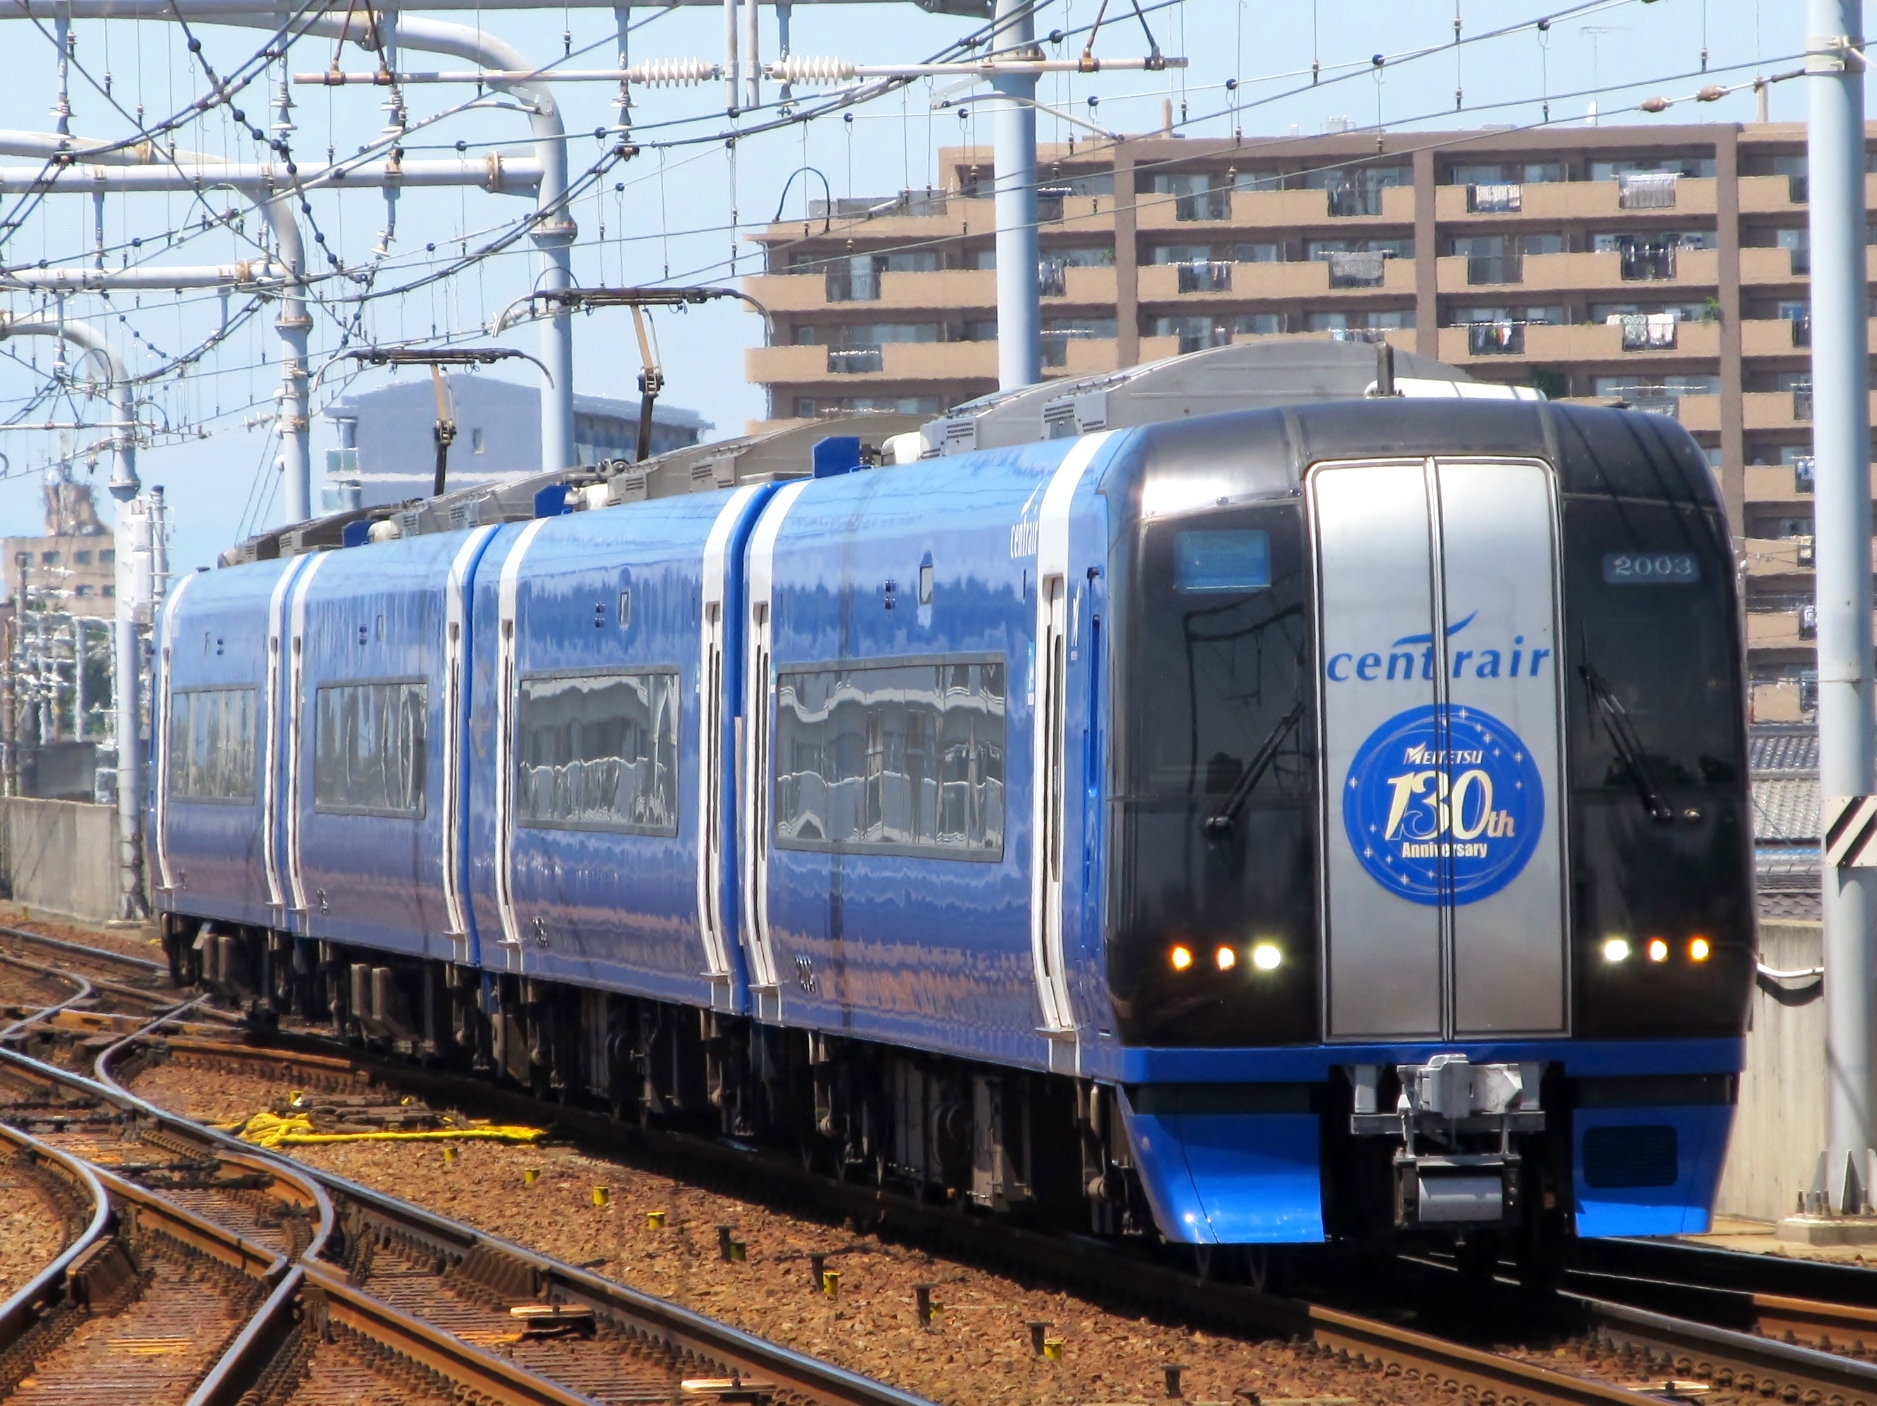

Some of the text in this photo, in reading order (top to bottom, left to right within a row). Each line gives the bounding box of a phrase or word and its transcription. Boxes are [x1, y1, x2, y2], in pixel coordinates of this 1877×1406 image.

[1614, 556, 1692, 576] 2003
[1326, 634, 1550, 682] centrair
[1402, 842, 1488, 859] Anniversary
